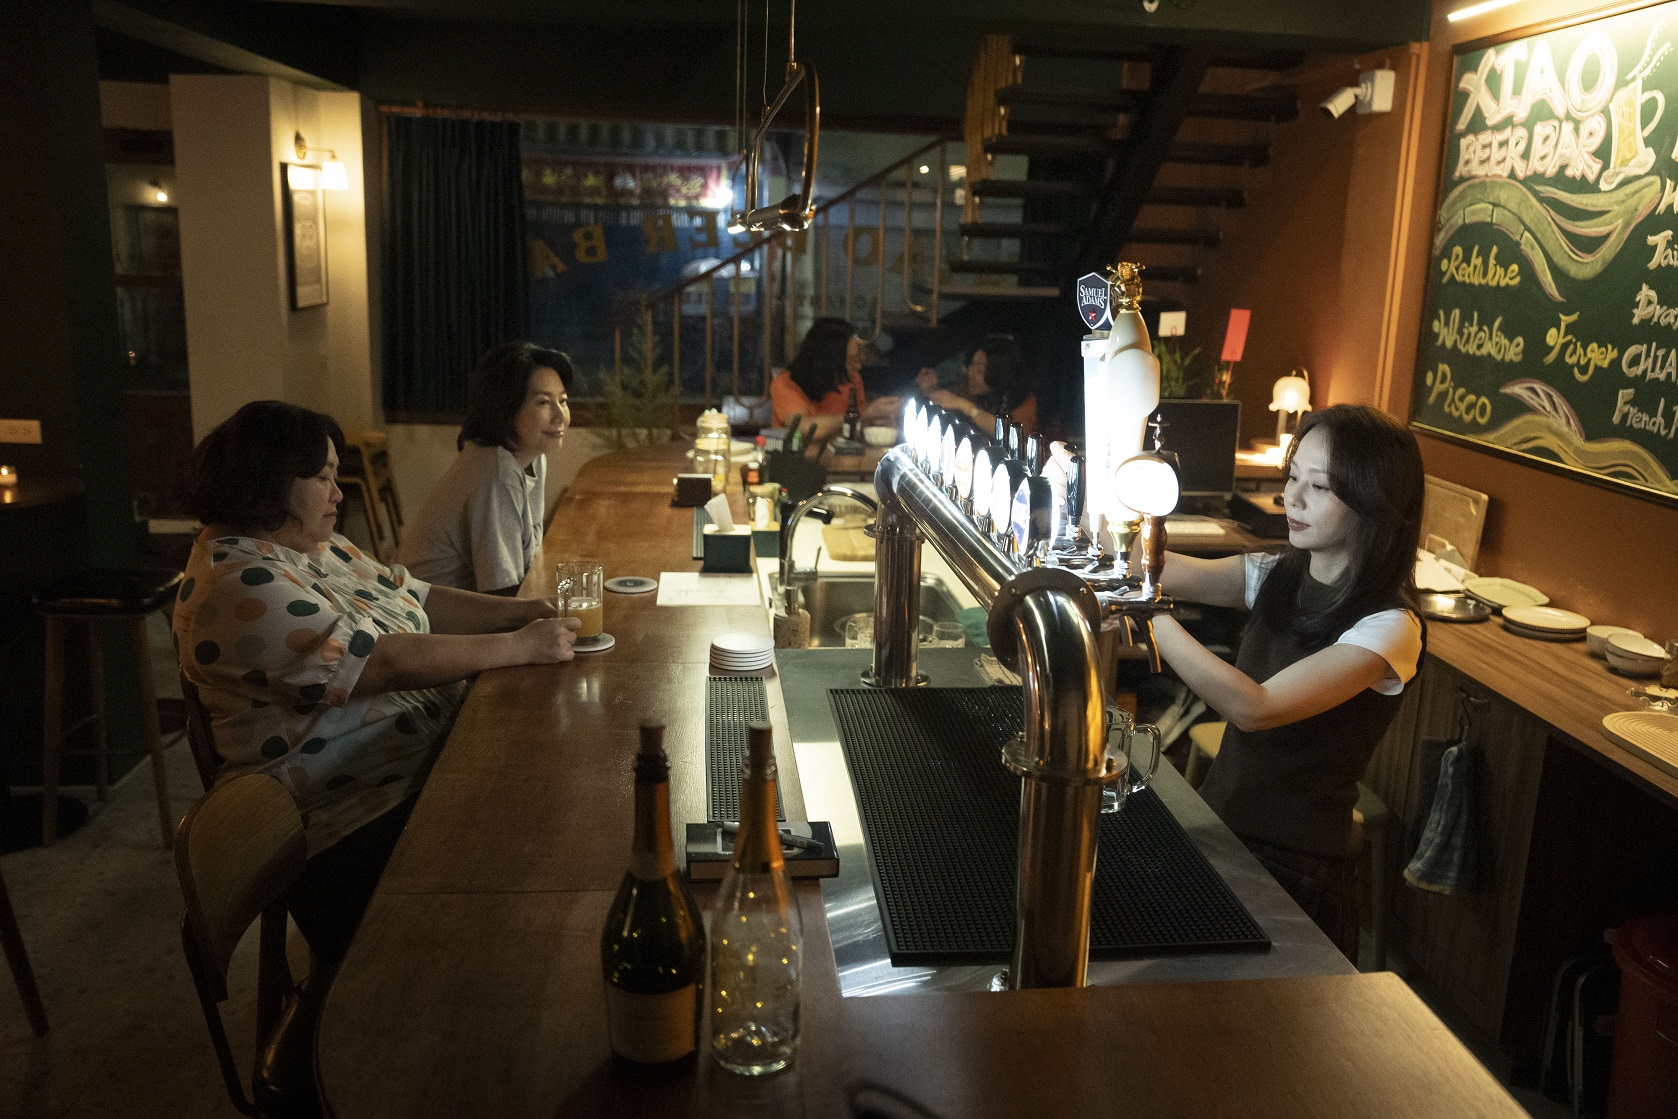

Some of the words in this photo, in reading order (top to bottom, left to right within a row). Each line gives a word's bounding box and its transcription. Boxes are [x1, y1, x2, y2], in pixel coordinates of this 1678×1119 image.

[1455, 30, 1619, 133] XIAO
[1453, 125, 1528, 180] BEER
[1526, 113, 1607, 184] BAR
[1080, 284, 1107, 300] SAMUEL
[1081, 295, 1105, 309] ADAMS
[1543, 311, 1618, 382] Finger
[1612, 387, 1668, 437] French
